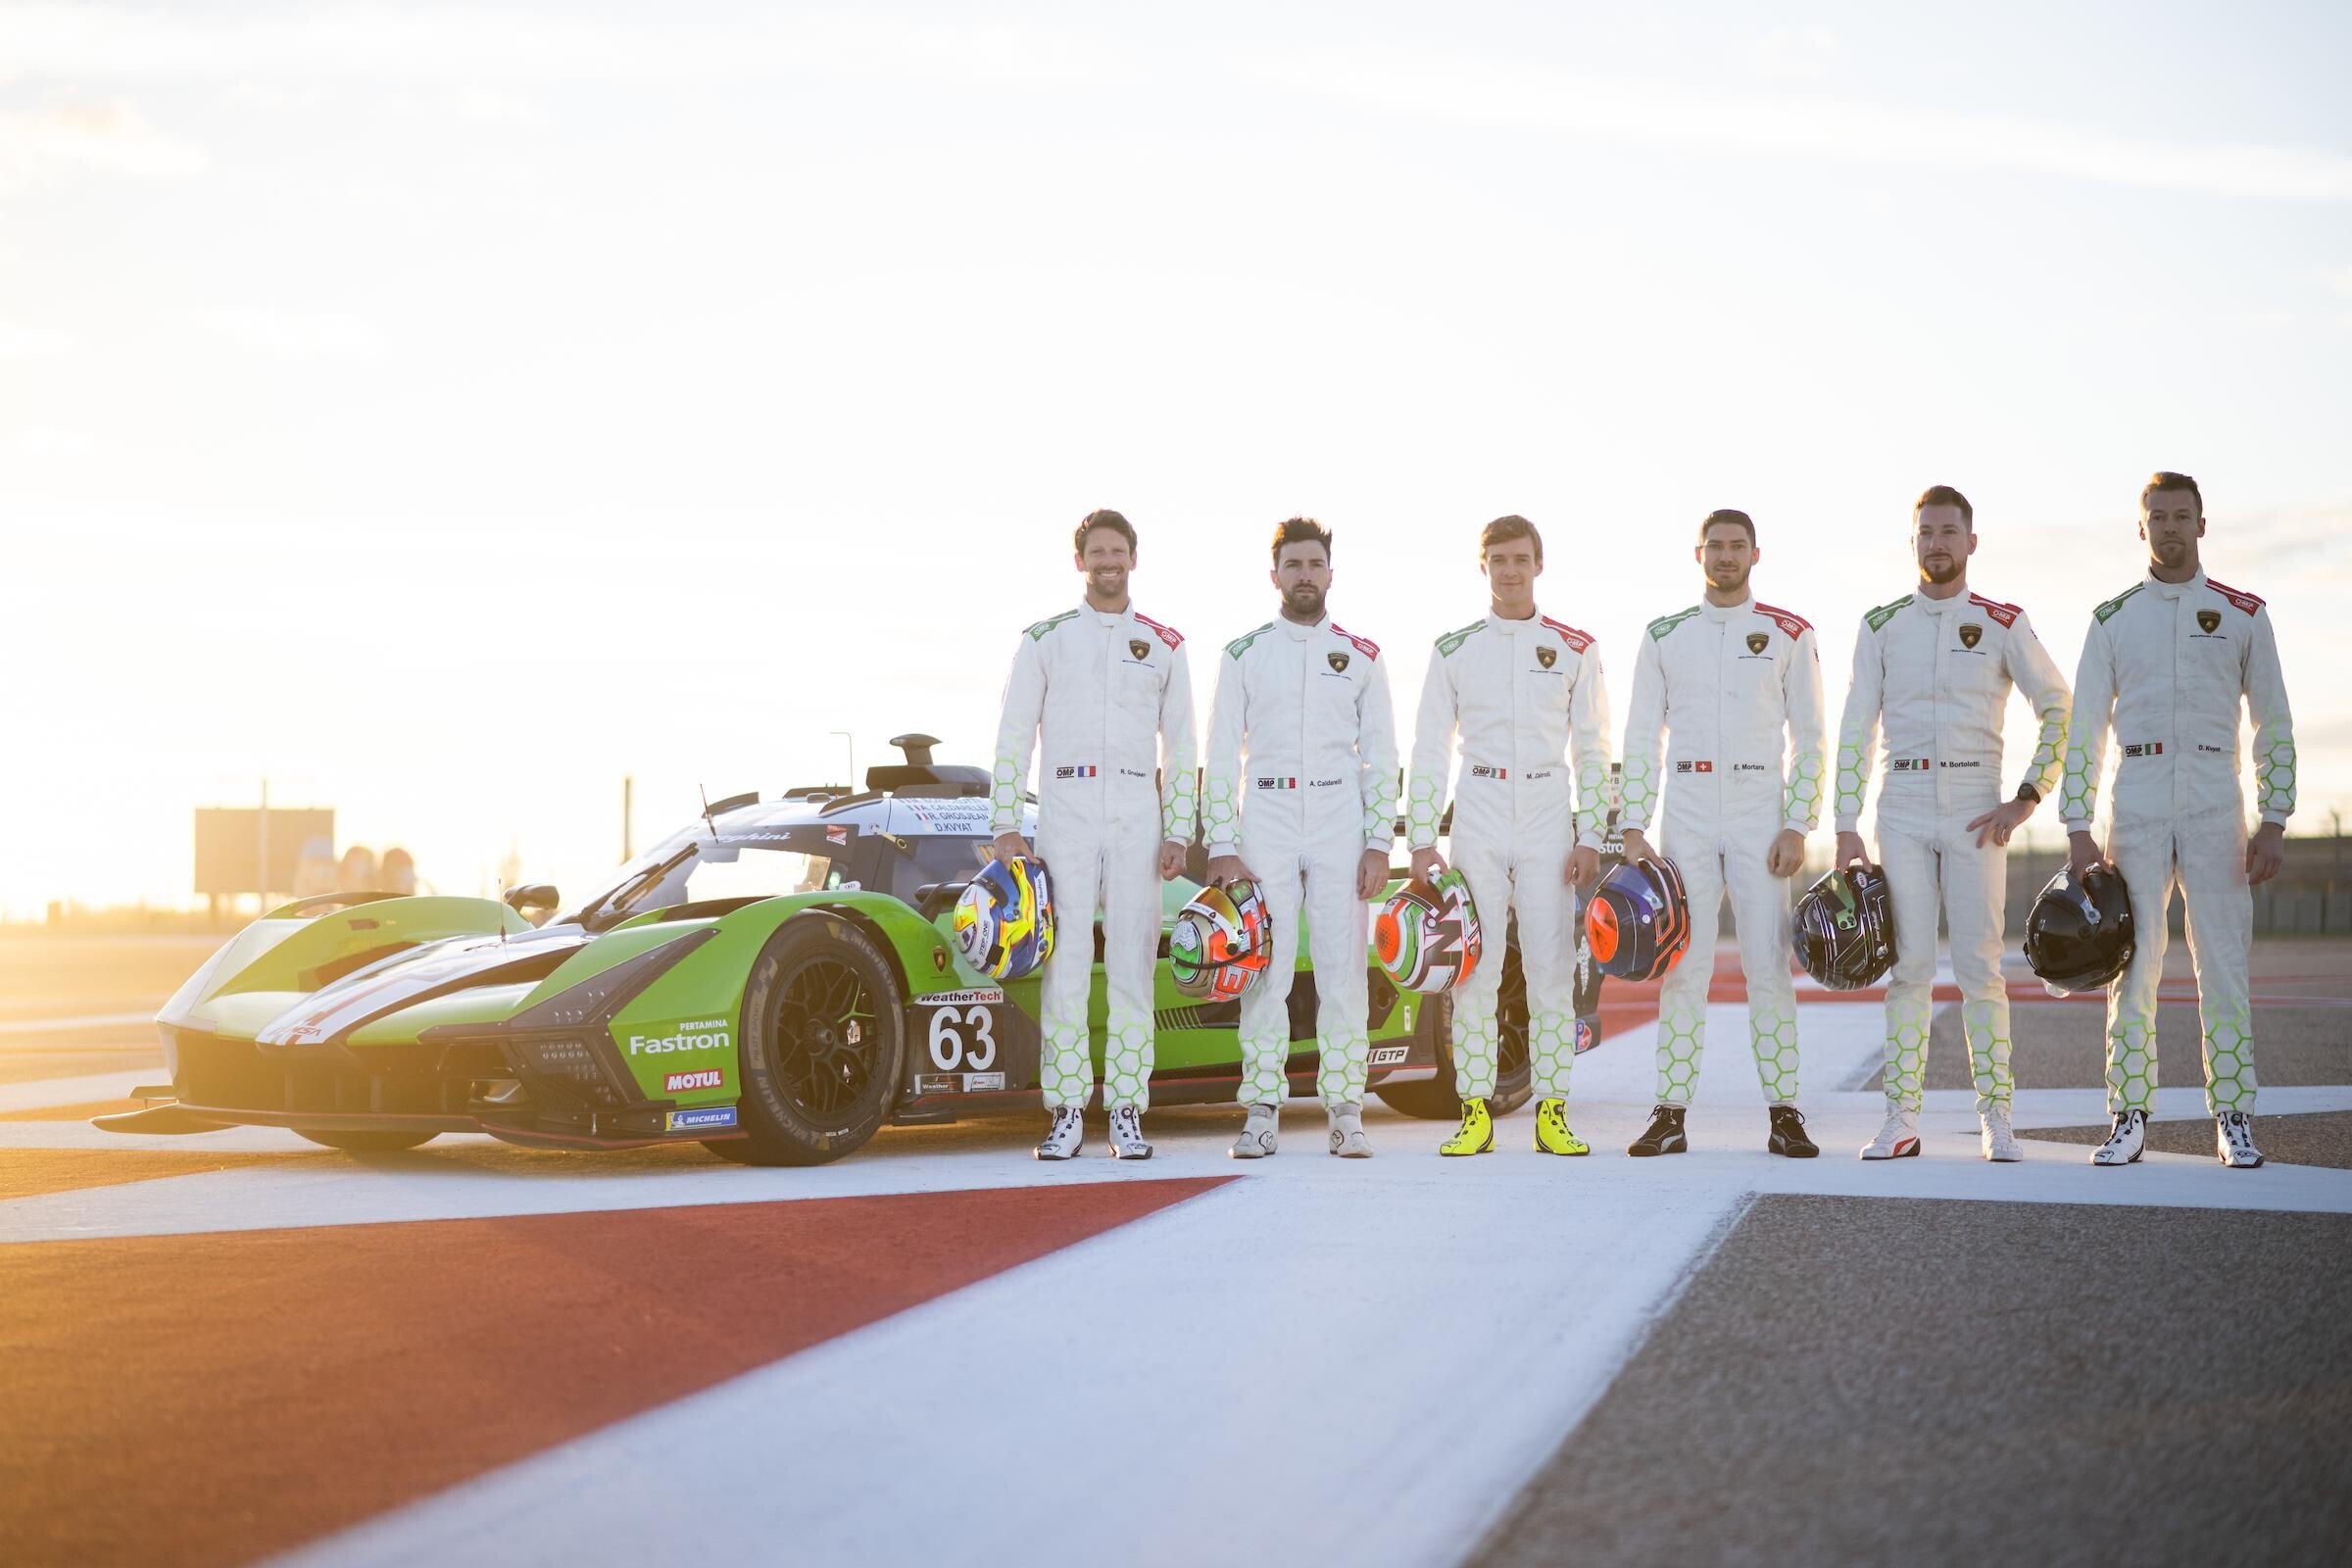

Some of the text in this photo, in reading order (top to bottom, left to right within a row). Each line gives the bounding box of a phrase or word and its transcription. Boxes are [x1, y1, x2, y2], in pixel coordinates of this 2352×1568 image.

[1894, 760, 1910, 769] OMP
[1056, 768, 1075, 777] OMP
[1257, 779, 1275, 788] OMP
[920, 990, 1002, 1003] WeatherTech
[679, 1019, 728, 1031] PERTAMINA
[928, 1004, 997, 1071] 63
[629, 1032, 730, 1055] Fastron
[1377, 1050, 1406, 1061] GTP
[666, 1070, 722, 1091] MOTUL
[686, 1113, 731, 1124] MICHELIN
